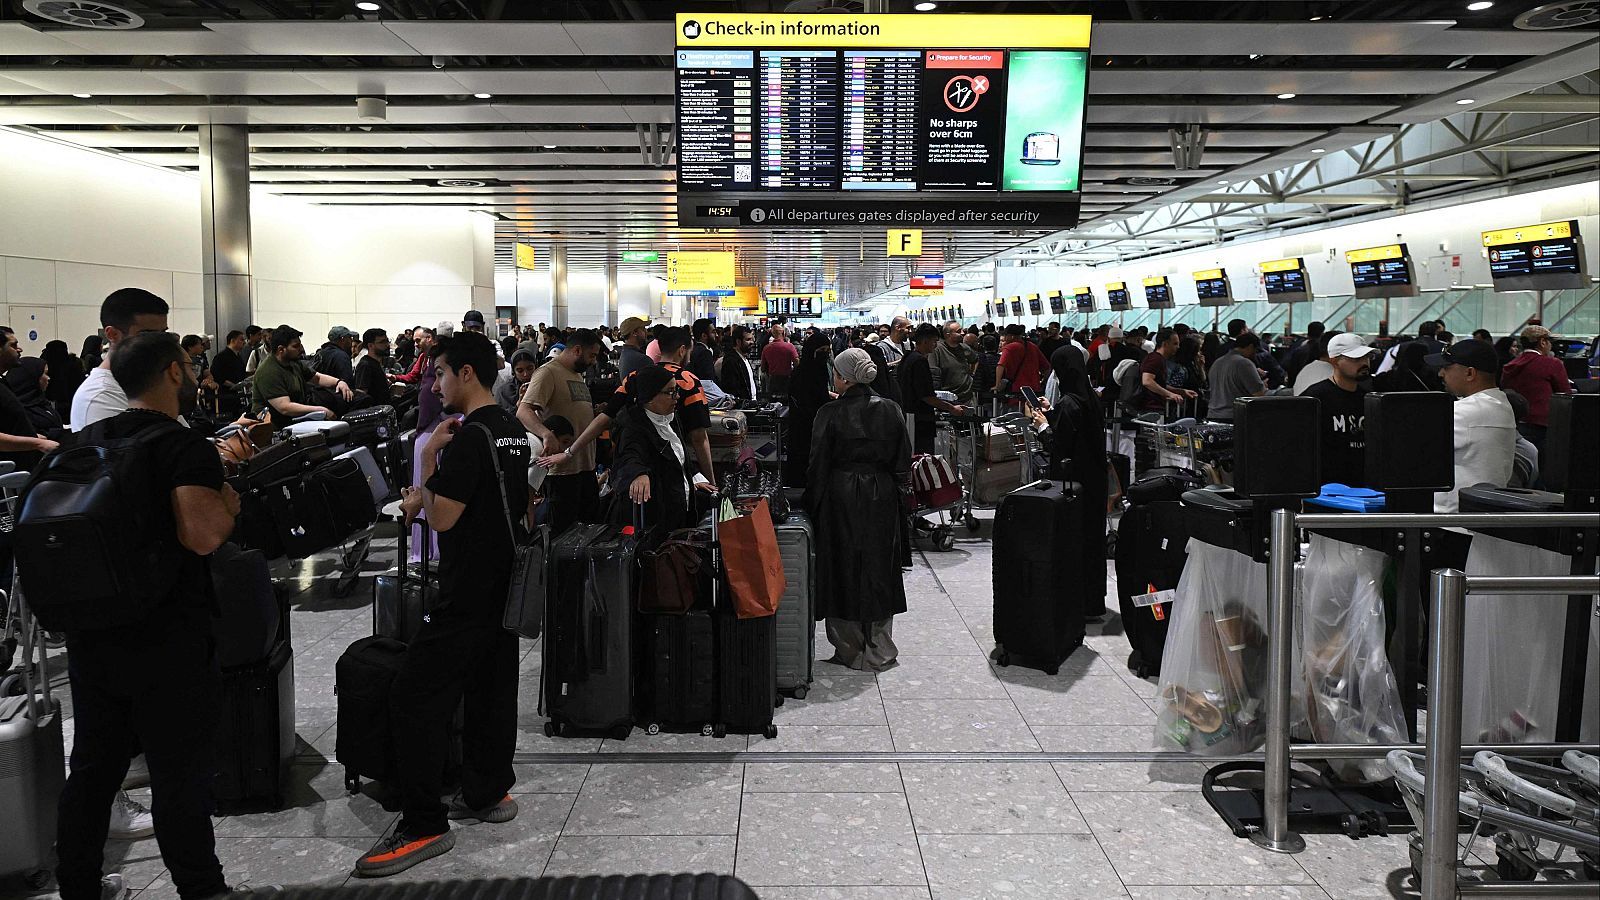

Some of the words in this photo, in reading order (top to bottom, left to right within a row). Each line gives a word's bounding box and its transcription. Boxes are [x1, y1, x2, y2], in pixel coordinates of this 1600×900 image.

[705, 21, 775, 35] Check-in
[781, 21, 880, 35] information
[930, 119, 944, 128] No
[945, 118, 978, 130] sharps
[929, 130, 952, 138] over
[953, 129, 973, 138] 6cm
[708, 208, 732, 216] 14:54
[768, 209, 783, 221] All
[787, 209, 856, 224] departures
[858, 211, 891, 223] gates
[894, 210, 956, 223] displayed
[958, 210, 988, 221] after
[990, 210, 1040, 224] security
[901, 234, 912, 252] F
